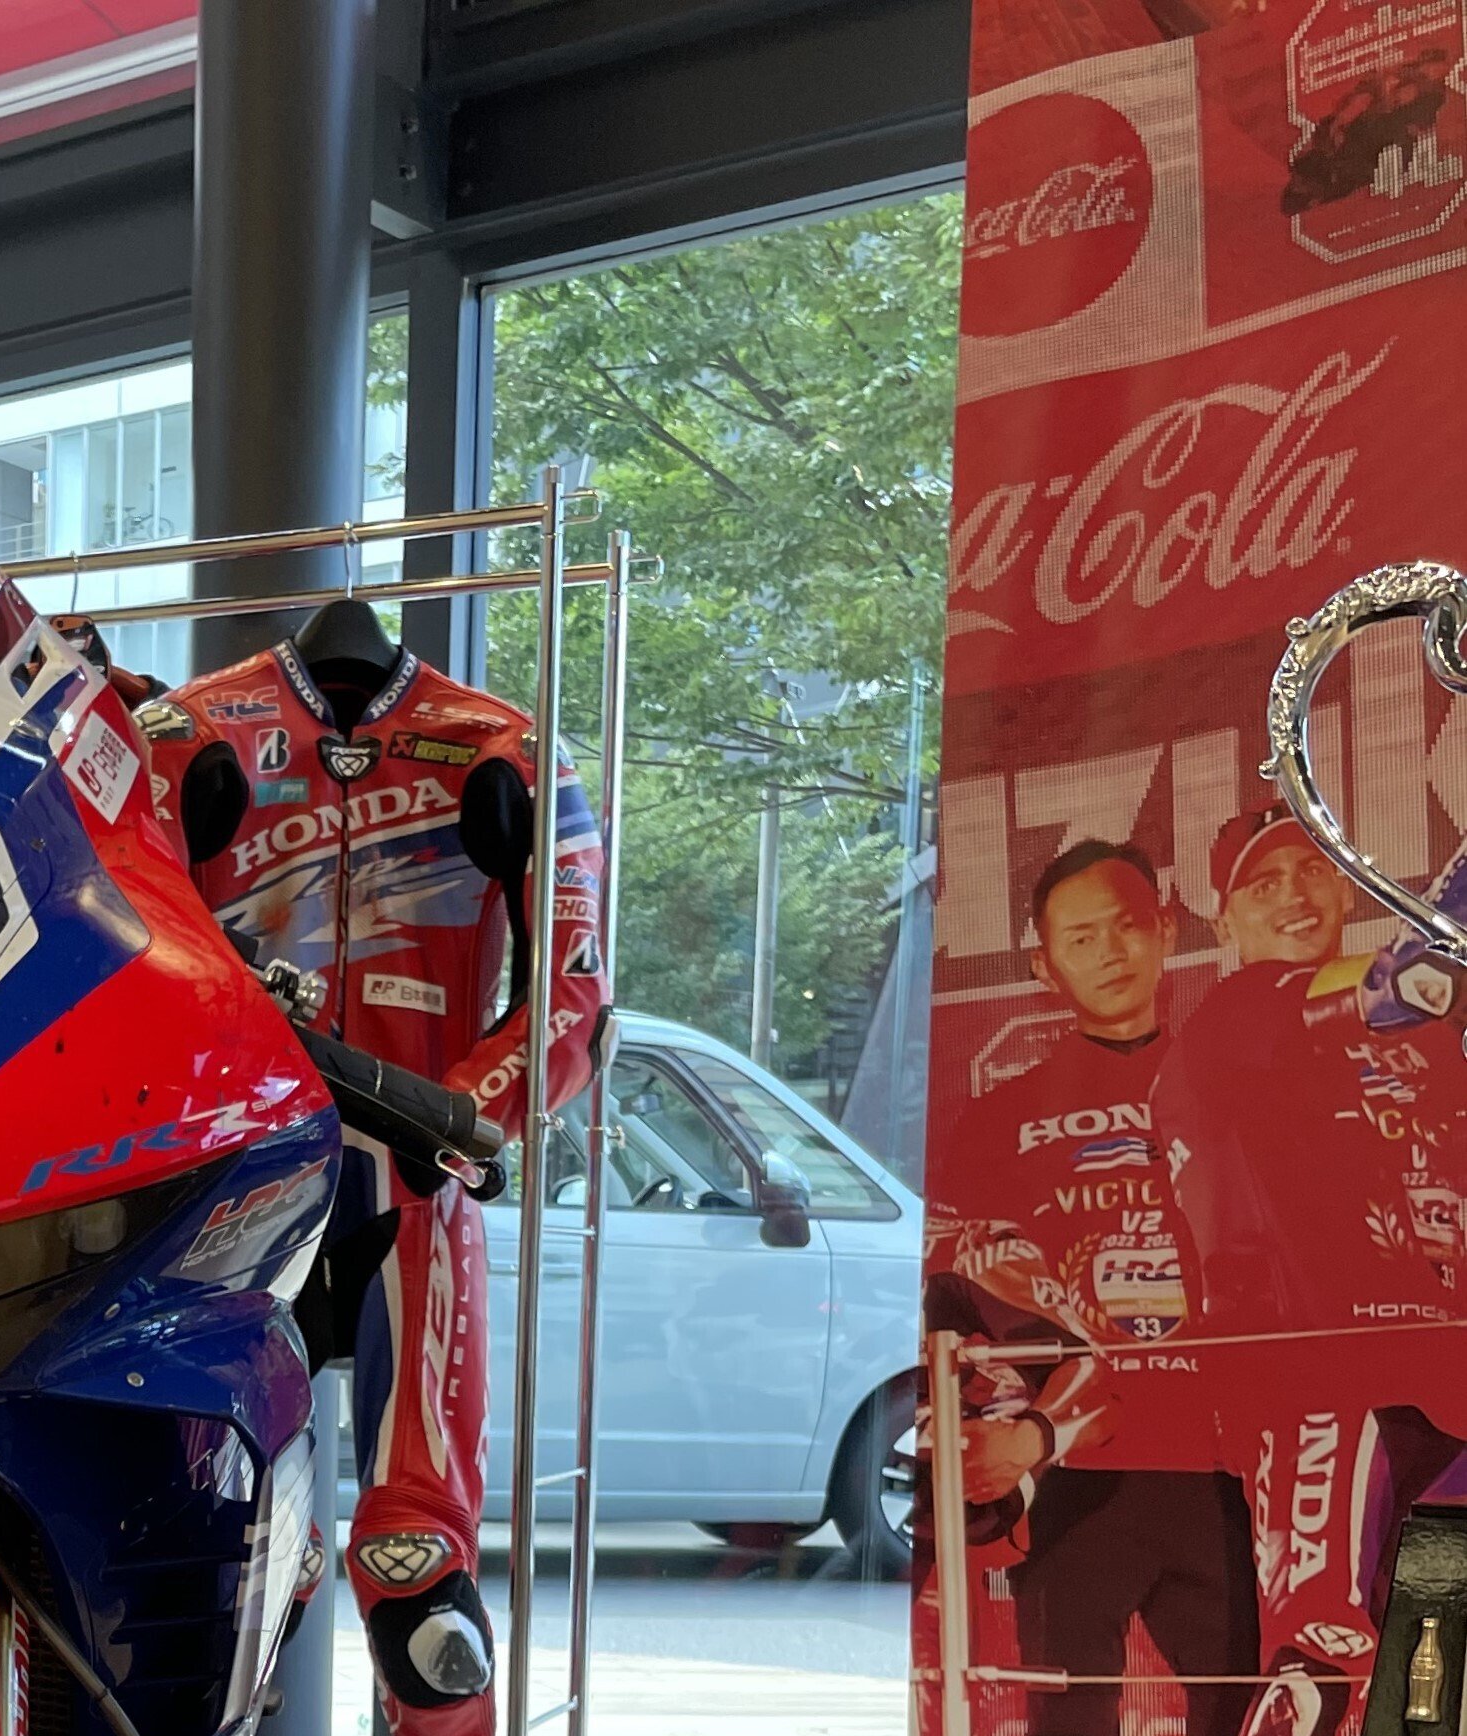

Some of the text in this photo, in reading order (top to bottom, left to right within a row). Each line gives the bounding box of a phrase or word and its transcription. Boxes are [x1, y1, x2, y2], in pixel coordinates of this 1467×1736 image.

[275, 641, 326, 720] HONDA
[230, 777, 460, 878] HONDA
[1018, 1103, 1152, 1155] HON
[1133, 1317, 1161, 1338] 33
[1288, 1413, 1340, 1595] NDA
